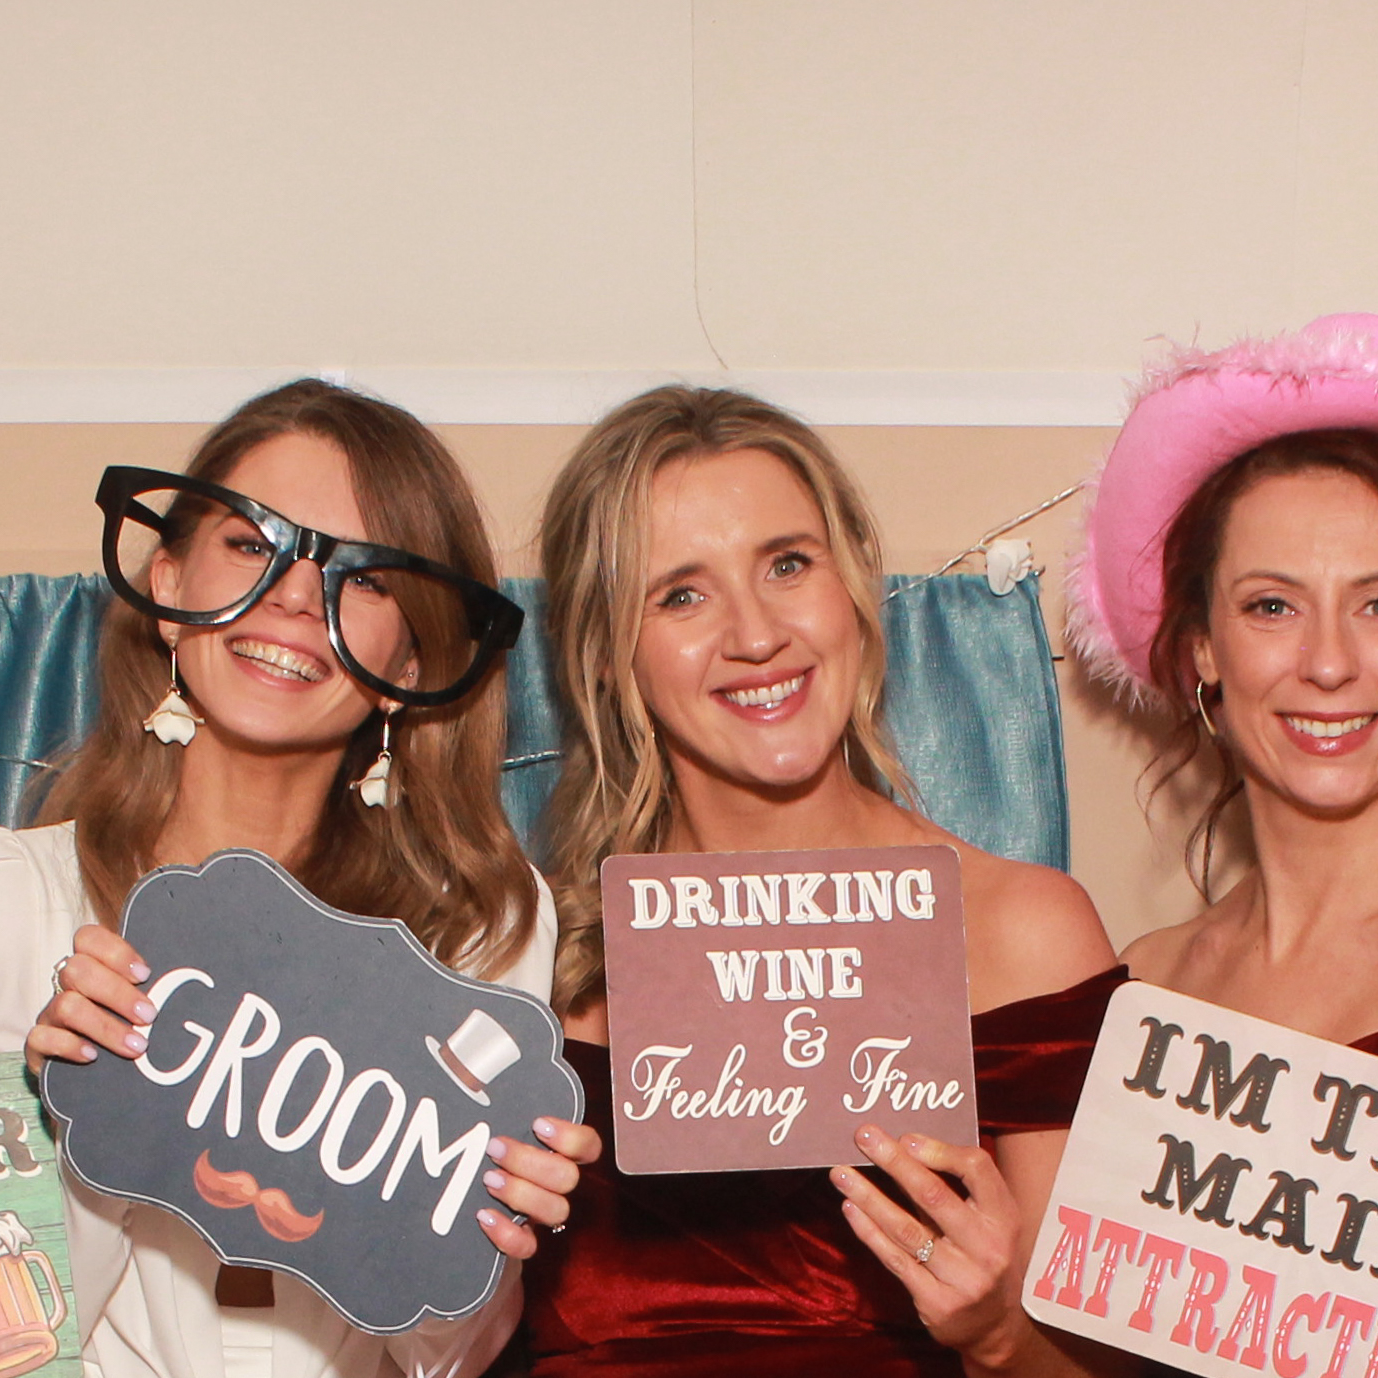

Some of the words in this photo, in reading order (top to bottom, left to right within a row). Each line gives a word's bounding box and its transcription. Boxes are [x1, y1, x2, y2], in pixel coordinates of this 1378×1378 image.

[628, 868, 935, 930] DRINKING
[705, 946, 863, 1002] WINE
[782, 1006, 828, 1068] &
[1122, 1015, 1290, 1134] IM
[132, 967, 491, 1236] GROOM
[623, 1043, 807, 1146] Feeling
[842, 1036, 964, 1113] Fine
